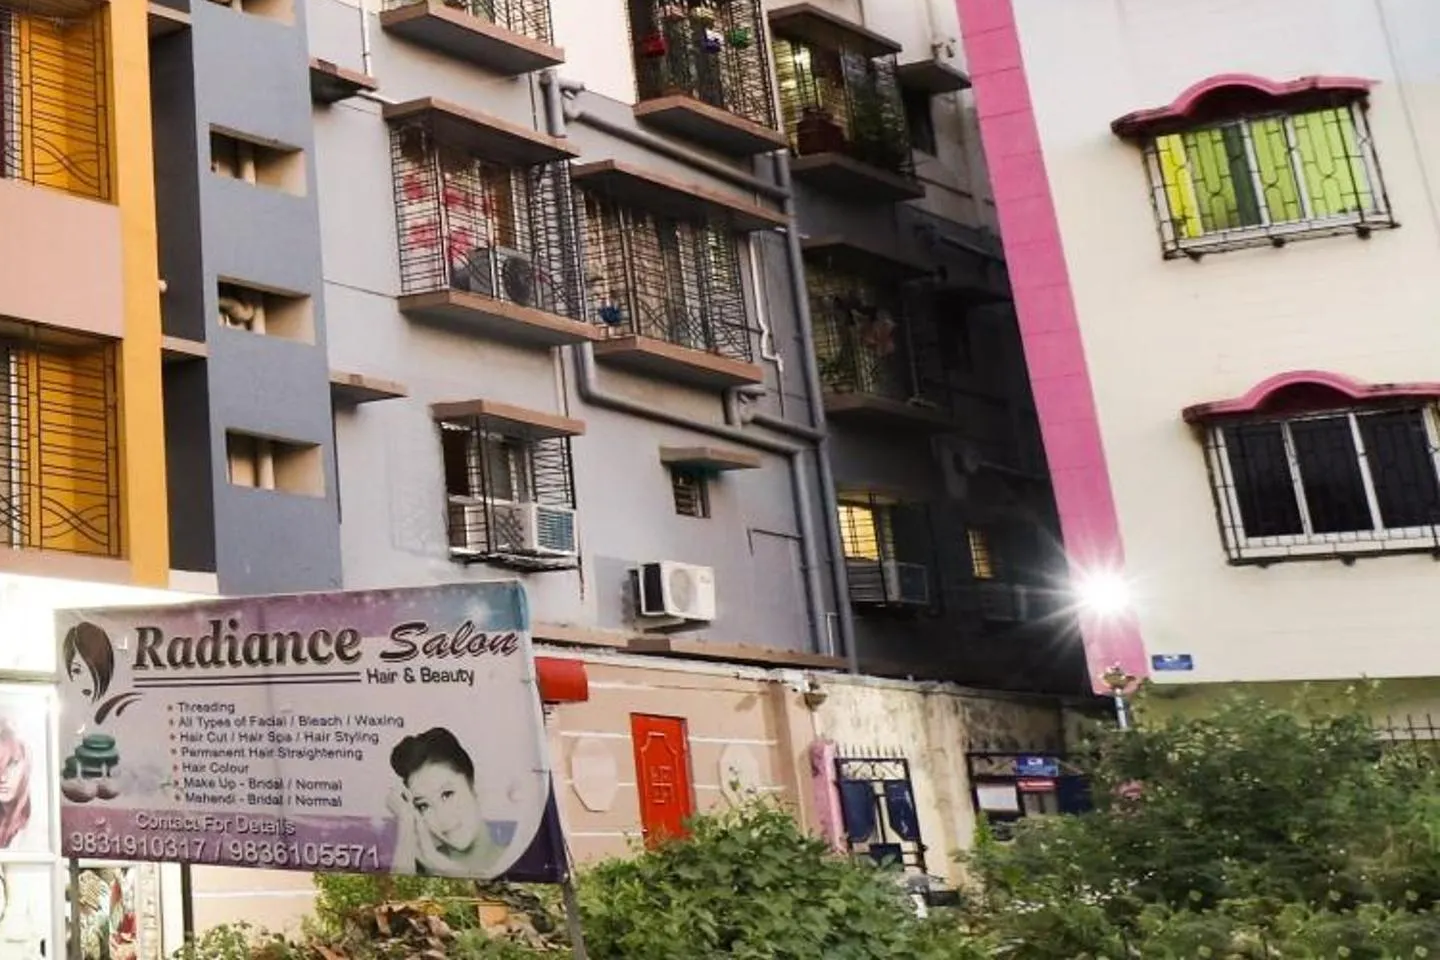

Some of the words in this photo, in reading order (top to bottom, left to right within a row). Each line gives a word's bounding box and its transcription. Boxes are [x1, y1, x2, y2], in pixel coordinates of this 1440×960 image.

[132, 619, 362, 670] Radiance
[379, 620, 520, 663] Salon
[367, 668, 398, 684] Hair
[403, 667, 415, 682] &
[421, 667, 475, 686] Beauty
[177, 702, 236, 715] Threading
[179, 716, 193, 727] All
[197, 716, 231, 730] Types
[234, 715, 247, 727] of
[248, 715, 287, 727] Facial
[298, 715, 343, 727] Bleach
[355, 714, 405, 728] Waxing
[180, 731, 203, 742] Hair
[207, 731, 228, 743] Cut
[239, 731, 263, 742] Hair
[268, 731, 292, 745] Spa
[304, 731, 331, 742] Hair
[335, 731, 380, 745] Styling
[249, 747, 274, 759] Hair
[278, 746, 364, 761] Straightening
[182, 762, 206, 773] Hair
[209, 762, 249, 774] Colour
[183, 777, 215, 789] Make
[219, 778, 237, 791] Up
[248, 777, 283, 790] Bridal
[295, 778, 343, 791] Normal
[247, 793, 283, 806] Bridal
[295, 795, 343, 807] Normal
[136, 811, 200, 832] Contact
[204, 814, 233, 834] For
[236, 814, 296, 836] Details
[71, 831, 204, 859] 9831910317
[229, 840, 381, 869] 9836105571
